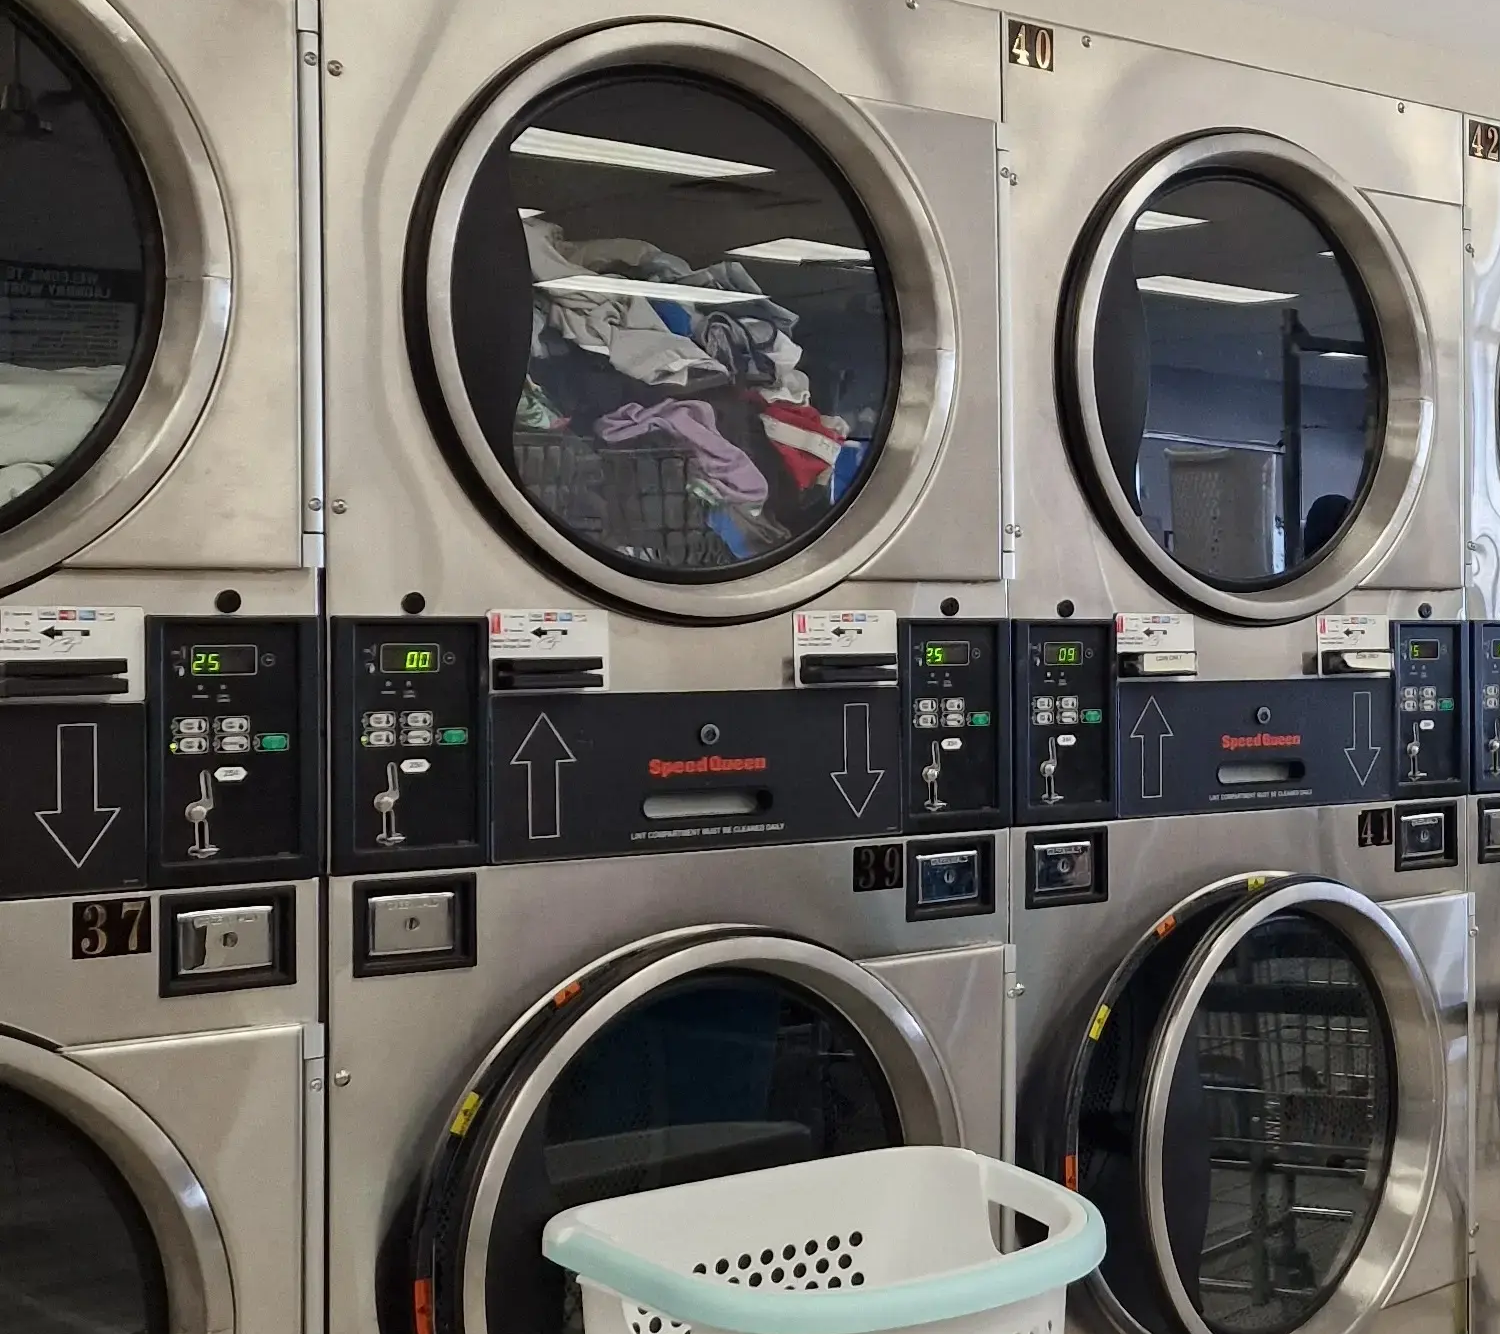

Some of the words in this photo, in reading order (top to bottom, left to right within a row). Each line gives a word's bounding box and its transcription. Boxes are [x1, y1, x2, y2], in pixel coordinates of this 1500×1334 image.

[1011, 23, 1053, 70] 40
[1472, 123, 1500, 159] 42
[192, 653, 221, 672] 25
[405, 651, 432, 668] 00
[1058, 647, 1076, 662] 09
[649, 756, 708, 777] Speed
[709, 755, 766, 771] Queen
[1361, 808, 1392, 847] 41
[859, 845, 902, 891] 39
[80, 901, 147, 956] 37
